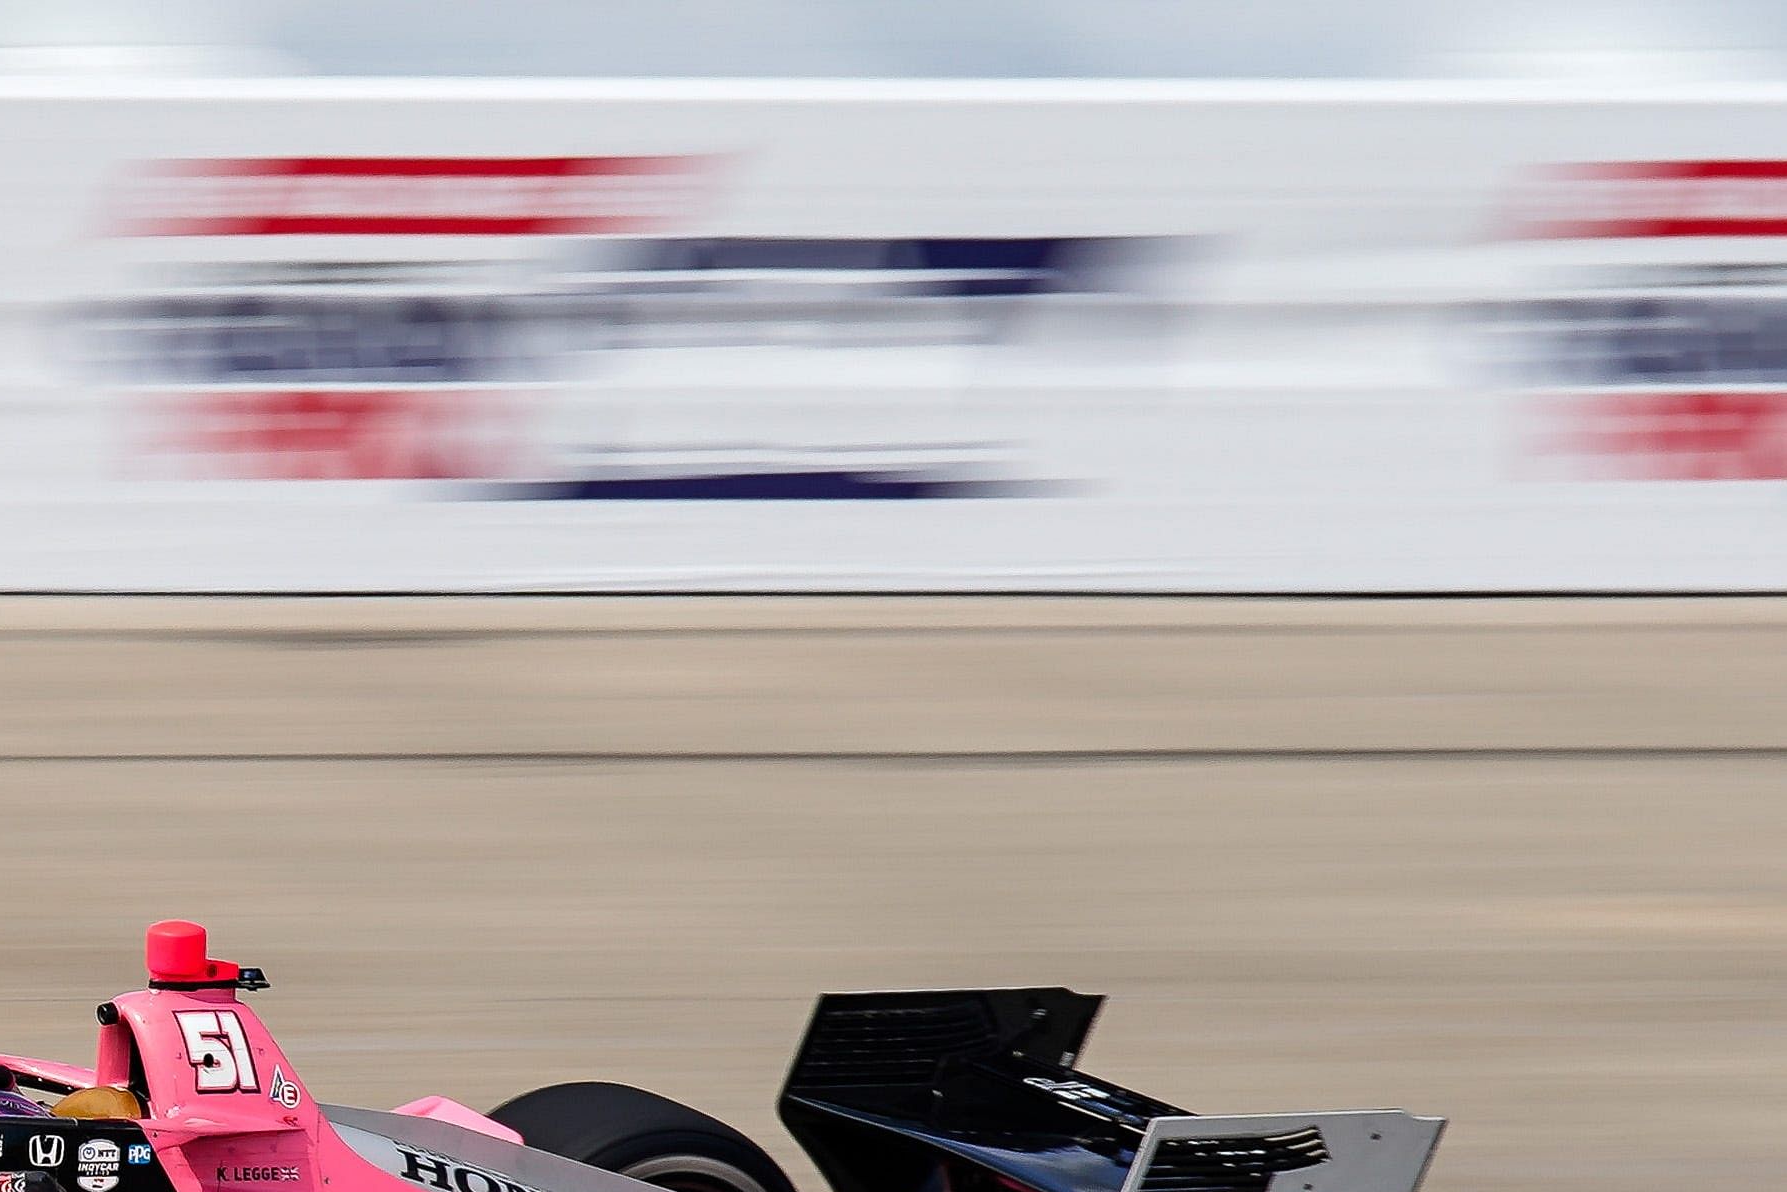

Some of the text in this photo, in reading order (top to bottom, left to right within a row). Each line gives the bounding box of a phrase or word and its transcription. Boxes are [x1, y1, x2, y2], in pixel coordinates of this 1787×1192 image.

[172, 1010, 261, 1095] 51
[128, 1145, 151, 1164] PPG
[77, 1162, 120, 1172] INDYCAR
[234, 1167, 280, 1182] LEGGE
